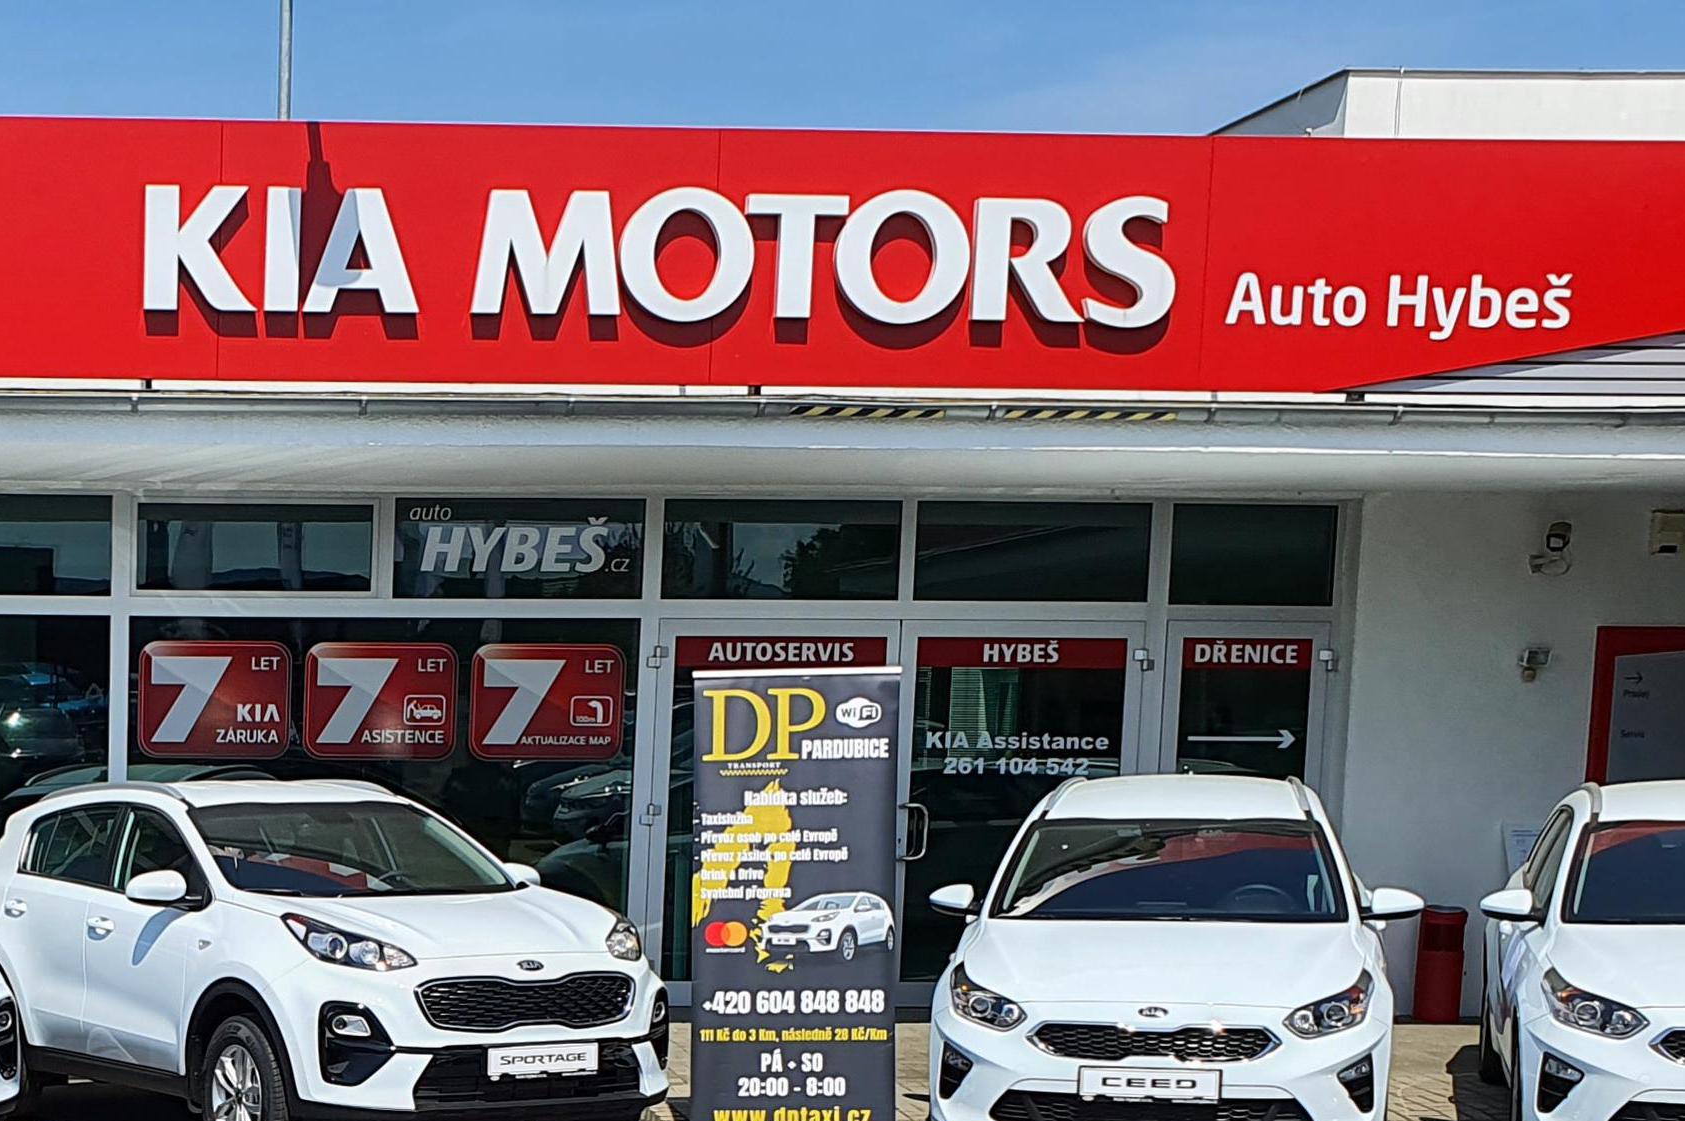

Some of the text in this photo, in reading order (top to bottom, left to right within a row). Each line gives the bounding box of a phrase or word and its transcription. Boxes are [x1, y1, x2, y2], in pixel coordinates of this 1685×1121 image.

[143, 184, 1176, 328] KIA MOTORS
[1226, 272, 1573, 341] Auto Hybeš
[409, 504, 452, 521] auto
[708, 642, 855, 662] AUTOSERVIS
[983, 640, 1060, 663] HYBEŠ
[1194, 641, 1299, 664] DŘENICE
[151, 656, 279, 744] 7 LET
[316, 658, 447, 745] 7 LET
[482, 659, 615, 746] 7 LET
[236, 703, 281, 723] KIA
[701, 687, 827, 762] DP
[215, 726, 280, 745] ZÁRUKA
[360, 729, 445, 745] ASISTENCE
[519, 734, 612, 745] AKTUALIZACE MAP
[925, 731, 1110, 751] KIA Assistance
[801, 737, 890, 760] PARDUBICE
[726, 761, 782, 770] TRANSPORT
[943, 757, 1090, 776] 261 104 542
[702, 989, 886, 1015] +420 604 848 848
[732, 1028, 747, 1042] do
[748, 1029, 757, 1042] 3
[781, 1026, 833, 1042] následně
[499, 1052, 588, 1066] SPORTAGE
[760, 1049, 784, 1073] PÁ
[800, 1052, 825, 1073] SO
[737, 1076, 790, 1097] 20:00
[805, 1076, 847, 1097] 8:00
[1101, 1076, 1197, 1089] CEED
